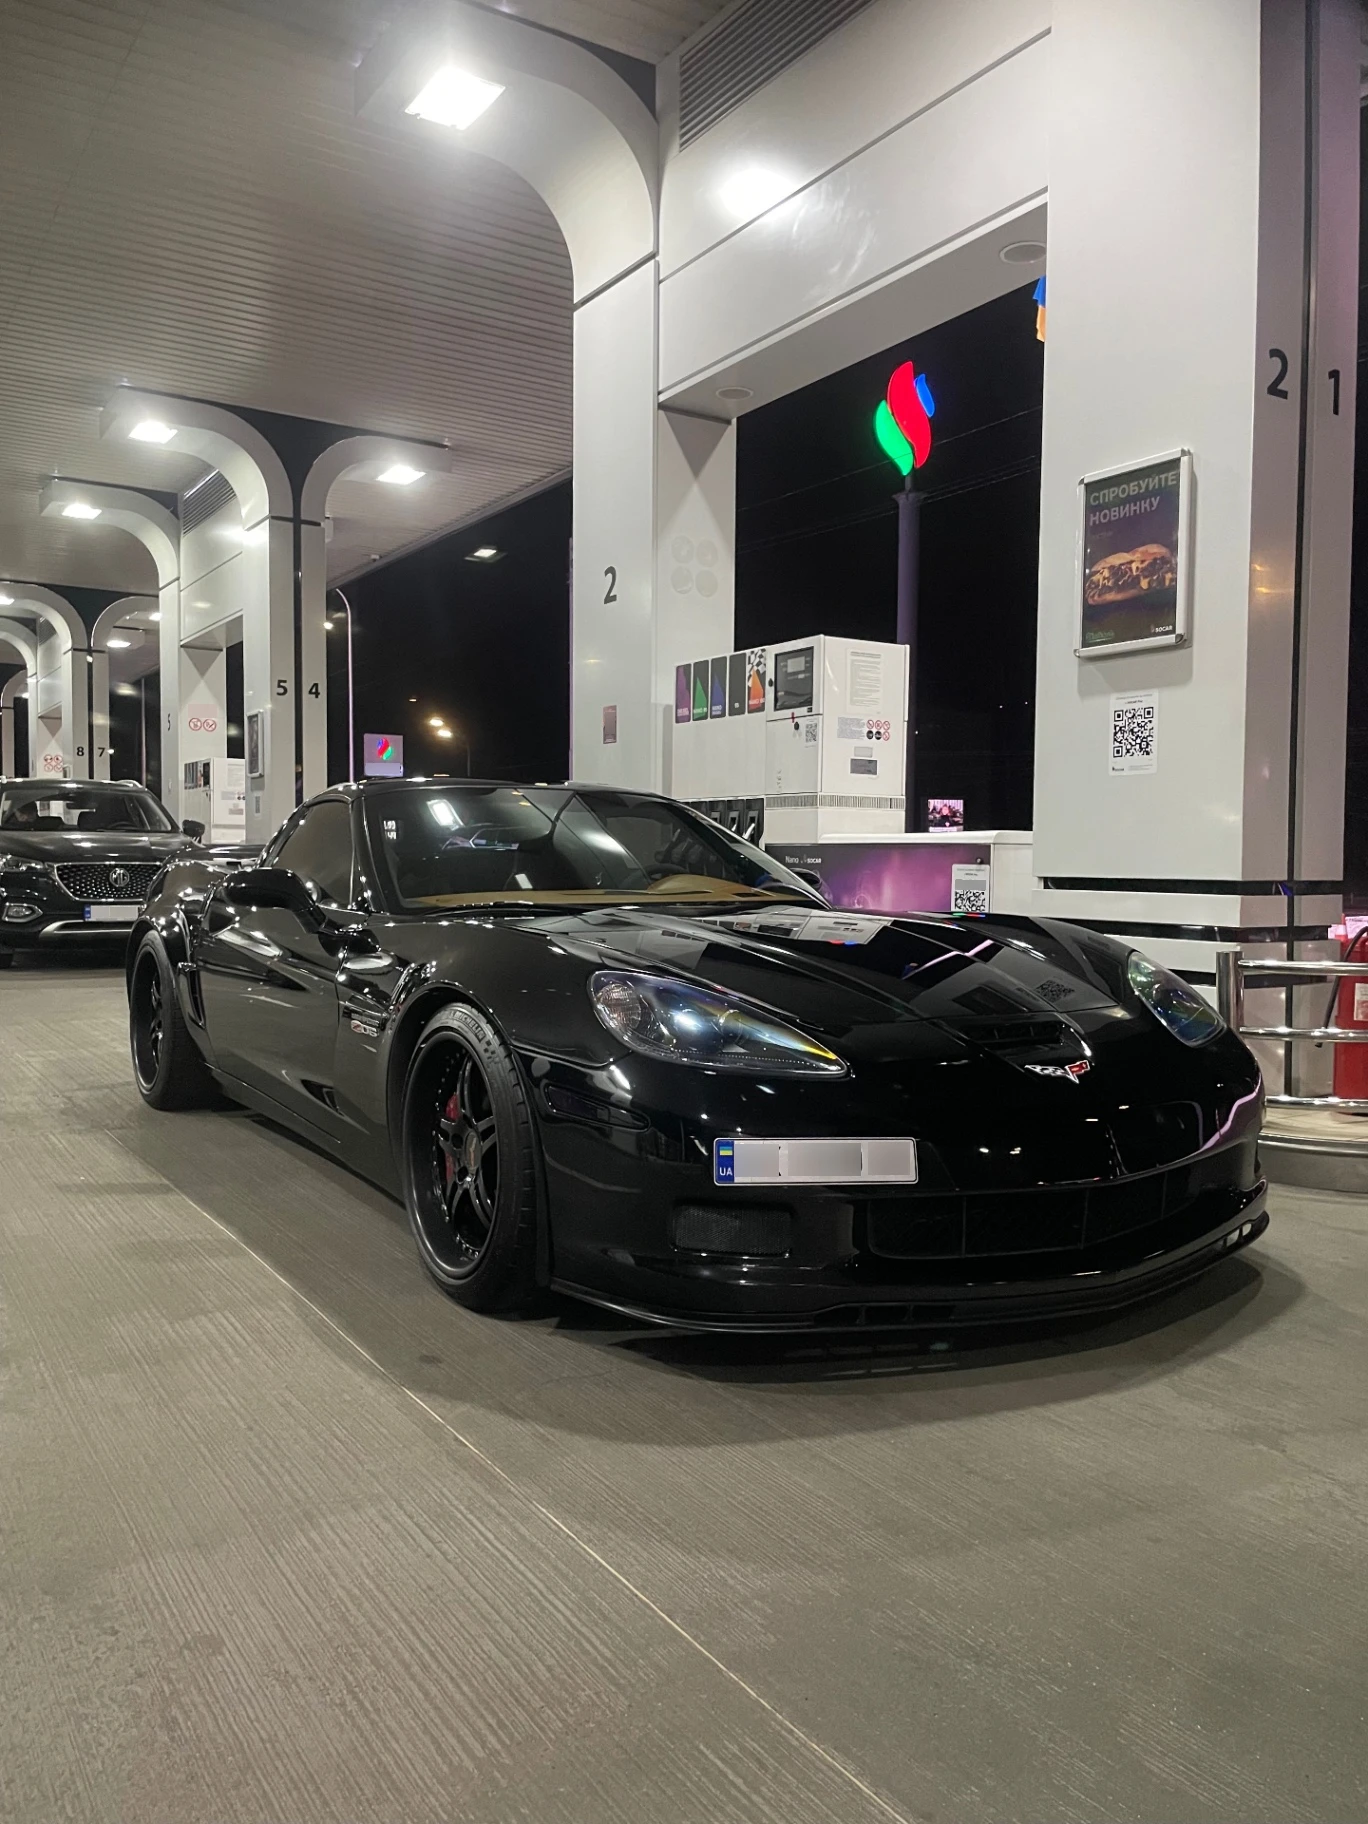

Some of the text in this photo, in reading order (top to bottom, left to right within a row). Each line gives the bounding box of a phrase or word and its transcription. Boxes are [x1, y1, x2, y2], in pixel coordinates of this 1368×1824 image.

[1266, 348, 1289, 400] 2
[1327, 368, 1340, 416] 1
[1090, 471, 1177, 506] СПРОБУЙТЕ
[1089, 496, 1160, 526] НОВИНКУ
[603, 566, 618, 605] 2
[1155, 625, 1173, 633] SOCAR
[276, 679, 288, 696] 5
[308, 682, 321, 699] 4
[76, 746, 85, 757] 8
[97, 746, 106, 757] 7
[719, 1166, 733, 1176] UA
